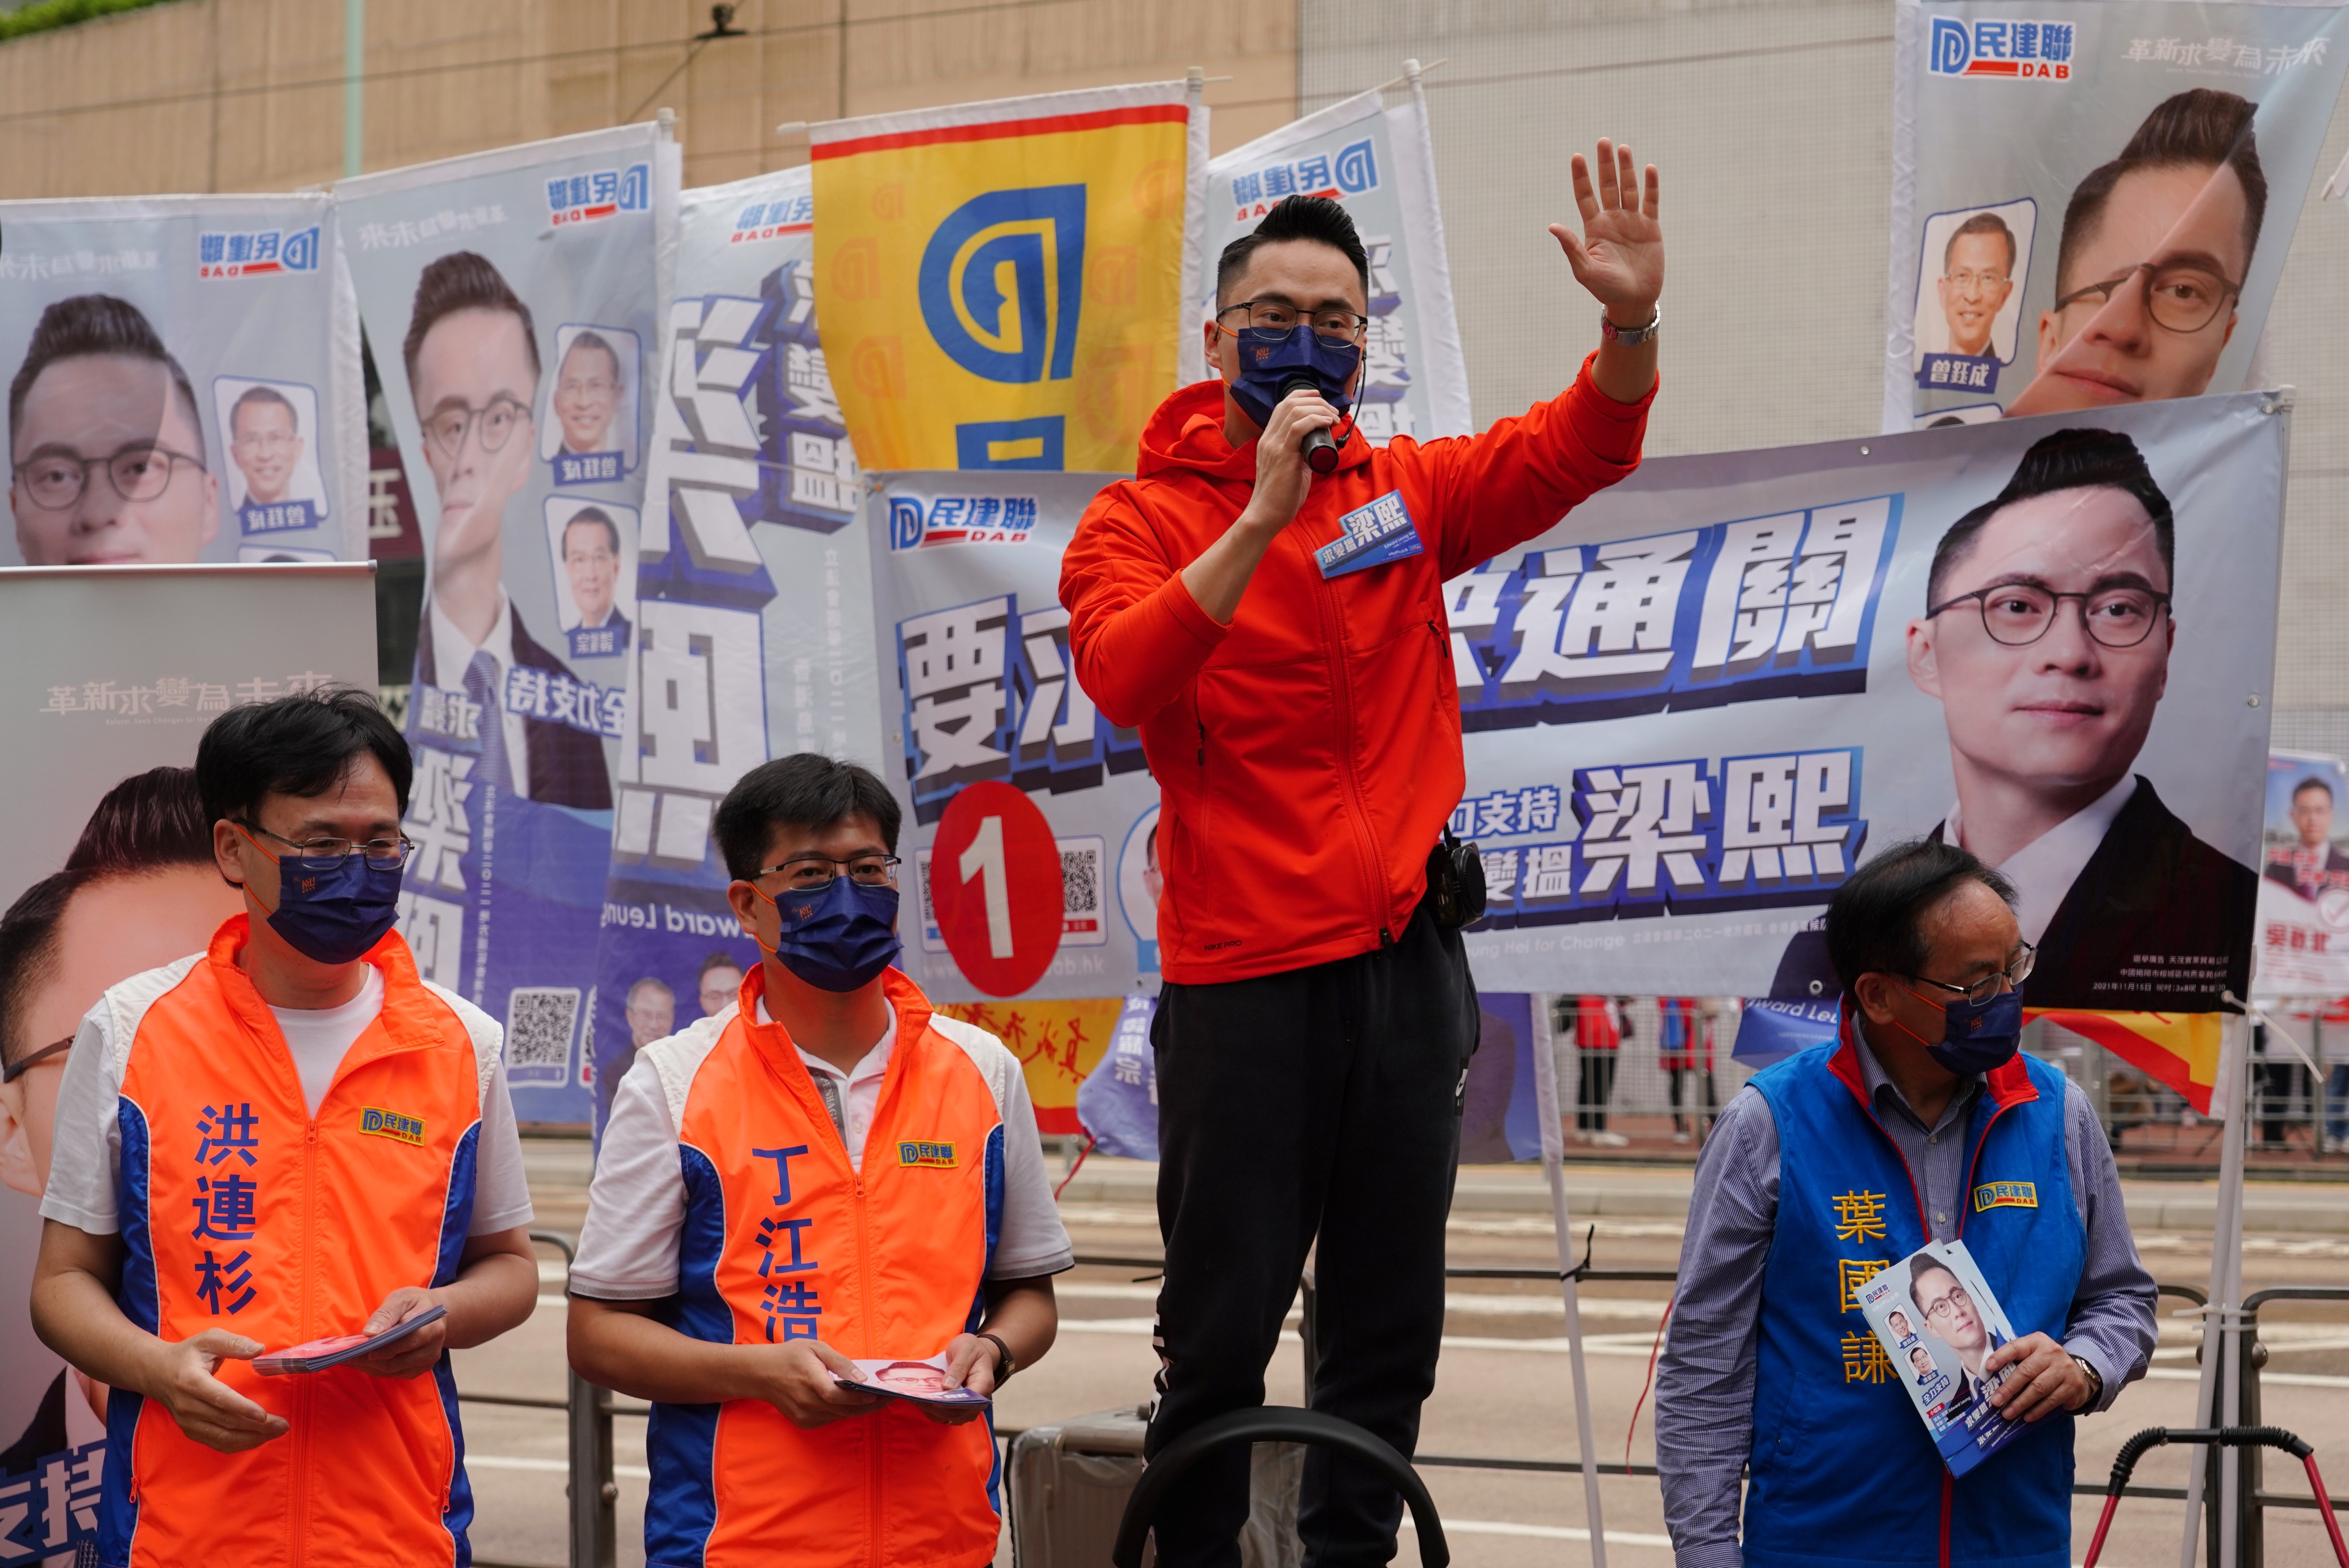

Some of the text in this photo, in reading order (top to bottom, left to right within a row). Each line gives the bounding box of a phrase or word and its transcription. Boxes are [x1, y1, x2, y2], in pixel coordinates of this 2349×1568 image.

[1973, 21, 2073, 61] 民建聯
[2022, 63, 2070, 79] DAB
[928, 497, 1038, 530] 民建聯
[1347, 495, 1407, 548] 梁熙
[970, 530, 1029, 542] DAB
[1322, 537, 1357, 564] 求變搵
[153, 717, 184, 726] Changes
[1442, 787, 1557, 838] 力支持
[1579, 751, 1851, 893] 梁熙
[958, 815, 1014, 959] 1
[1204, 940, 1243, 952] NIKE PRO
[1504, 939, 1529, 955] Hei
[1534, 937, 1556, 953] for
[1560, 933, 1626, 956] Change
[385, 1113, 423, 1136] 民建聯
[401, 1133, 421, 1143] DAB
[919, 1144, 952, 1158] 民建聯
[1996, 1185, 2033, 1198] 民建聯
[191, 1103, 259, 1315] 洪連杉
[752, 1144, 823, 1343] 丁江浩
[1832, 1190, 1899, 1384] 葉國謙
[1923, 1376, 1950, 1405] 全力支持
[1964, 1403, 1989, 1428] 求變搵
